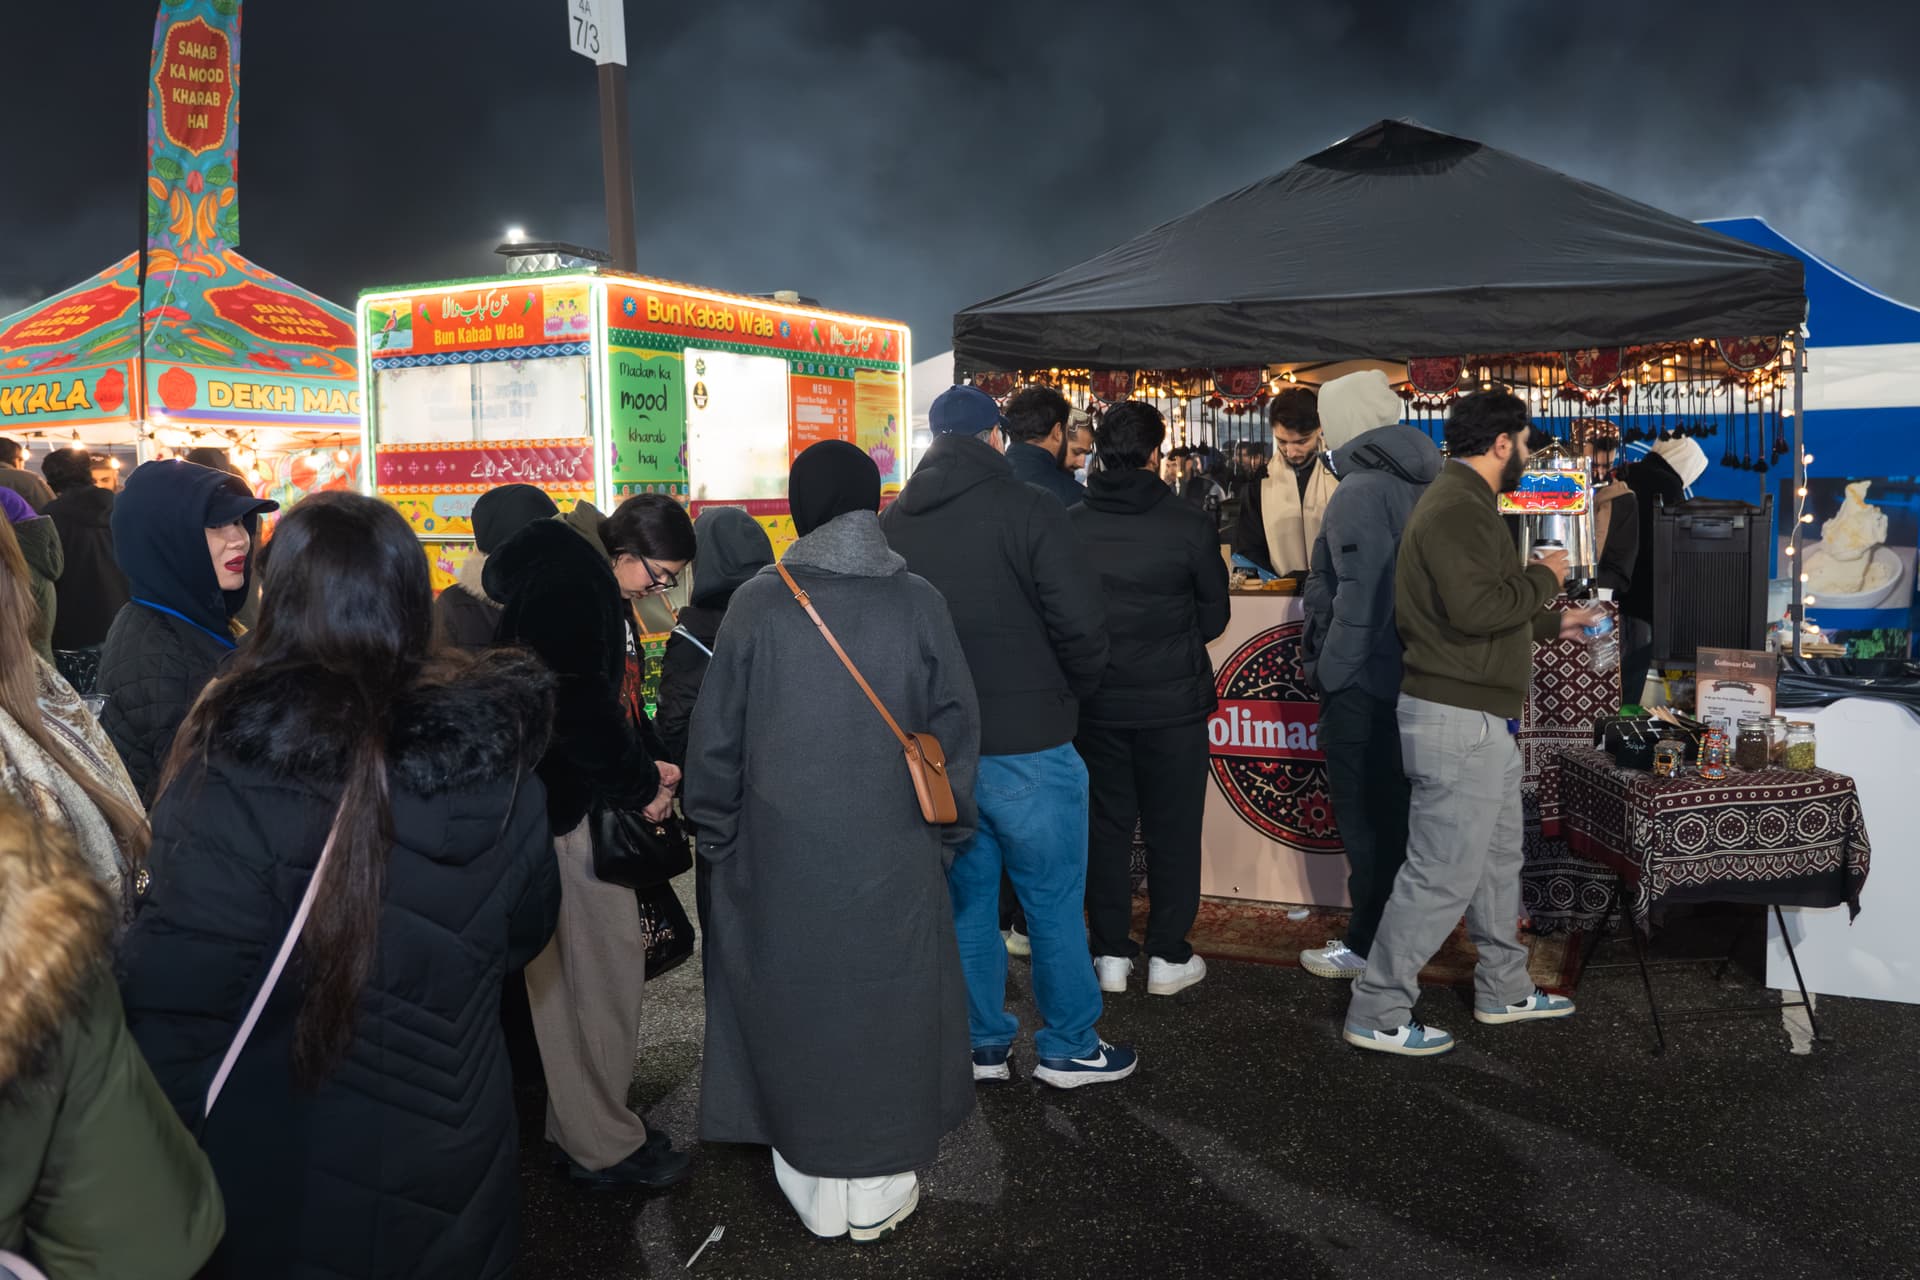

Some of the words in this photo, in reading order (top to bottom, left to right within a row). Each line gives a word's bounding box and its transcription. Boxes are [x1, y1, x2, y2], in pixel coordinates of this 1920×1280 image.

[573, 16, 600, 54] 7/3
[178, 41, 217, 60] SAHAB
[170, 64, 187, 80] KA
[189, 67, 224, 83] MOOD
[172, 88, 221, 107] KHARAB
[188, 114, 208, 129] HAI
[252, 303, 303, 316] BUN
[646, 295, 682, 325] Bun
[684, 301, 735, 332] Kabab
[737, 309, 775, 338] Wala
[251, 314, 329, 329] KABAB
[270, 325, 337, 338] WALA
[434, 329, 455, 346] Bun
[458, 326, 492, 344] Kabab
[495, 323, 525, 341] Wala
[619, 361, 657, 379] Madam
[658, 363, 671, 381] ka
[0, 378, 93, 416] WALA
[208, 381, 296, 412] DEKH
[620, 384, 667, 412] mood
[628, 427, 666, 444] kharab
[638, 450, 658, 470] hay
